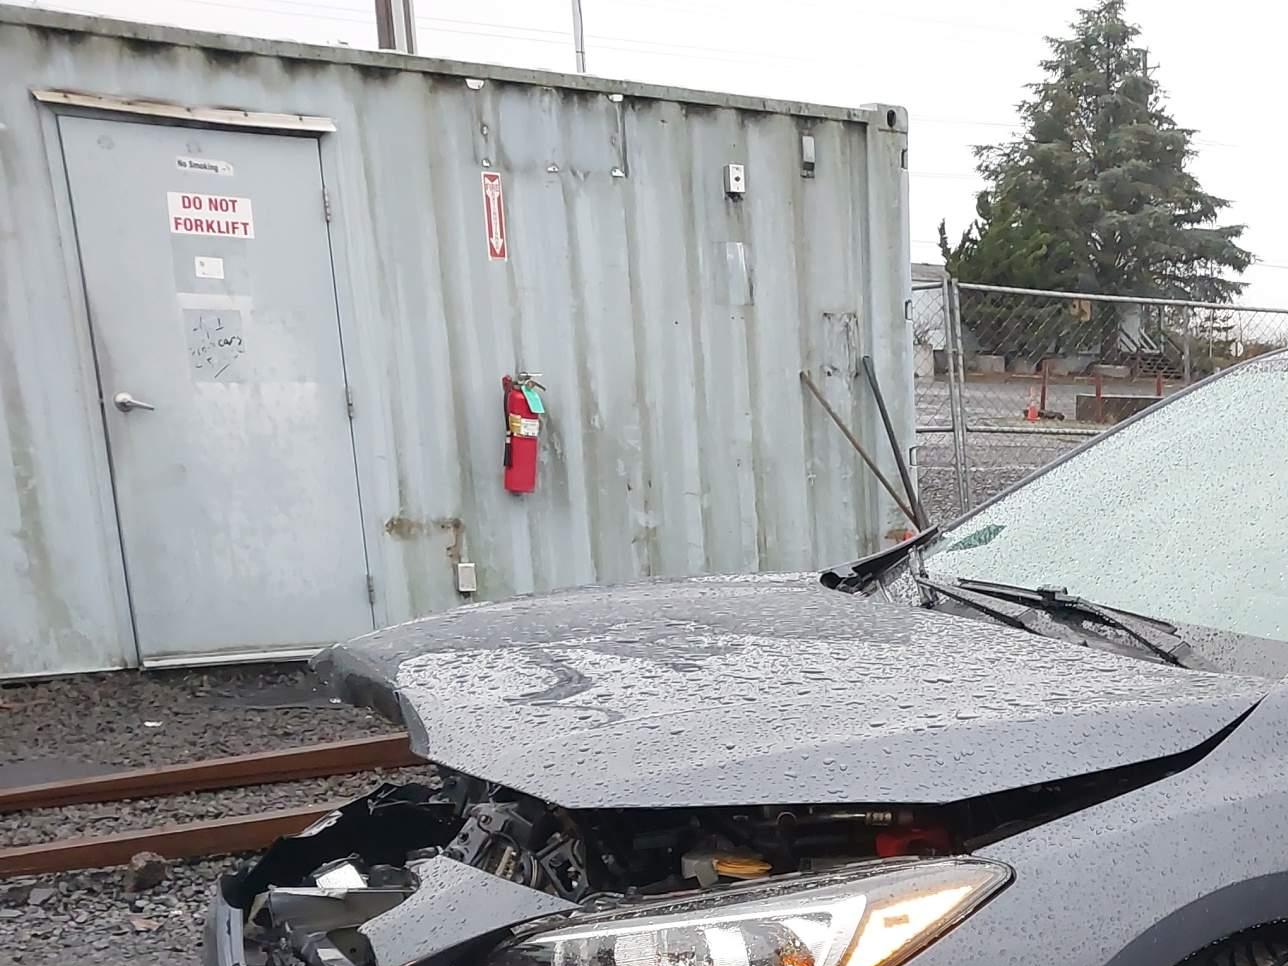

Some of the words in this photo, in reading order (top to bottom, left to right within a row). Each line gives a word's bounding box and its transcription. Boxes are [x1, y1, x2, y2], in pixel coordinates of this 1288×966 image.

[177, 160, 187, 168] No
[189, 160, 219, 173] Smoking
[181, 195, 203, 210] DO
[208, 197, 238, 213] NOT
[173, 216, 250, 236] FORKLIFT
